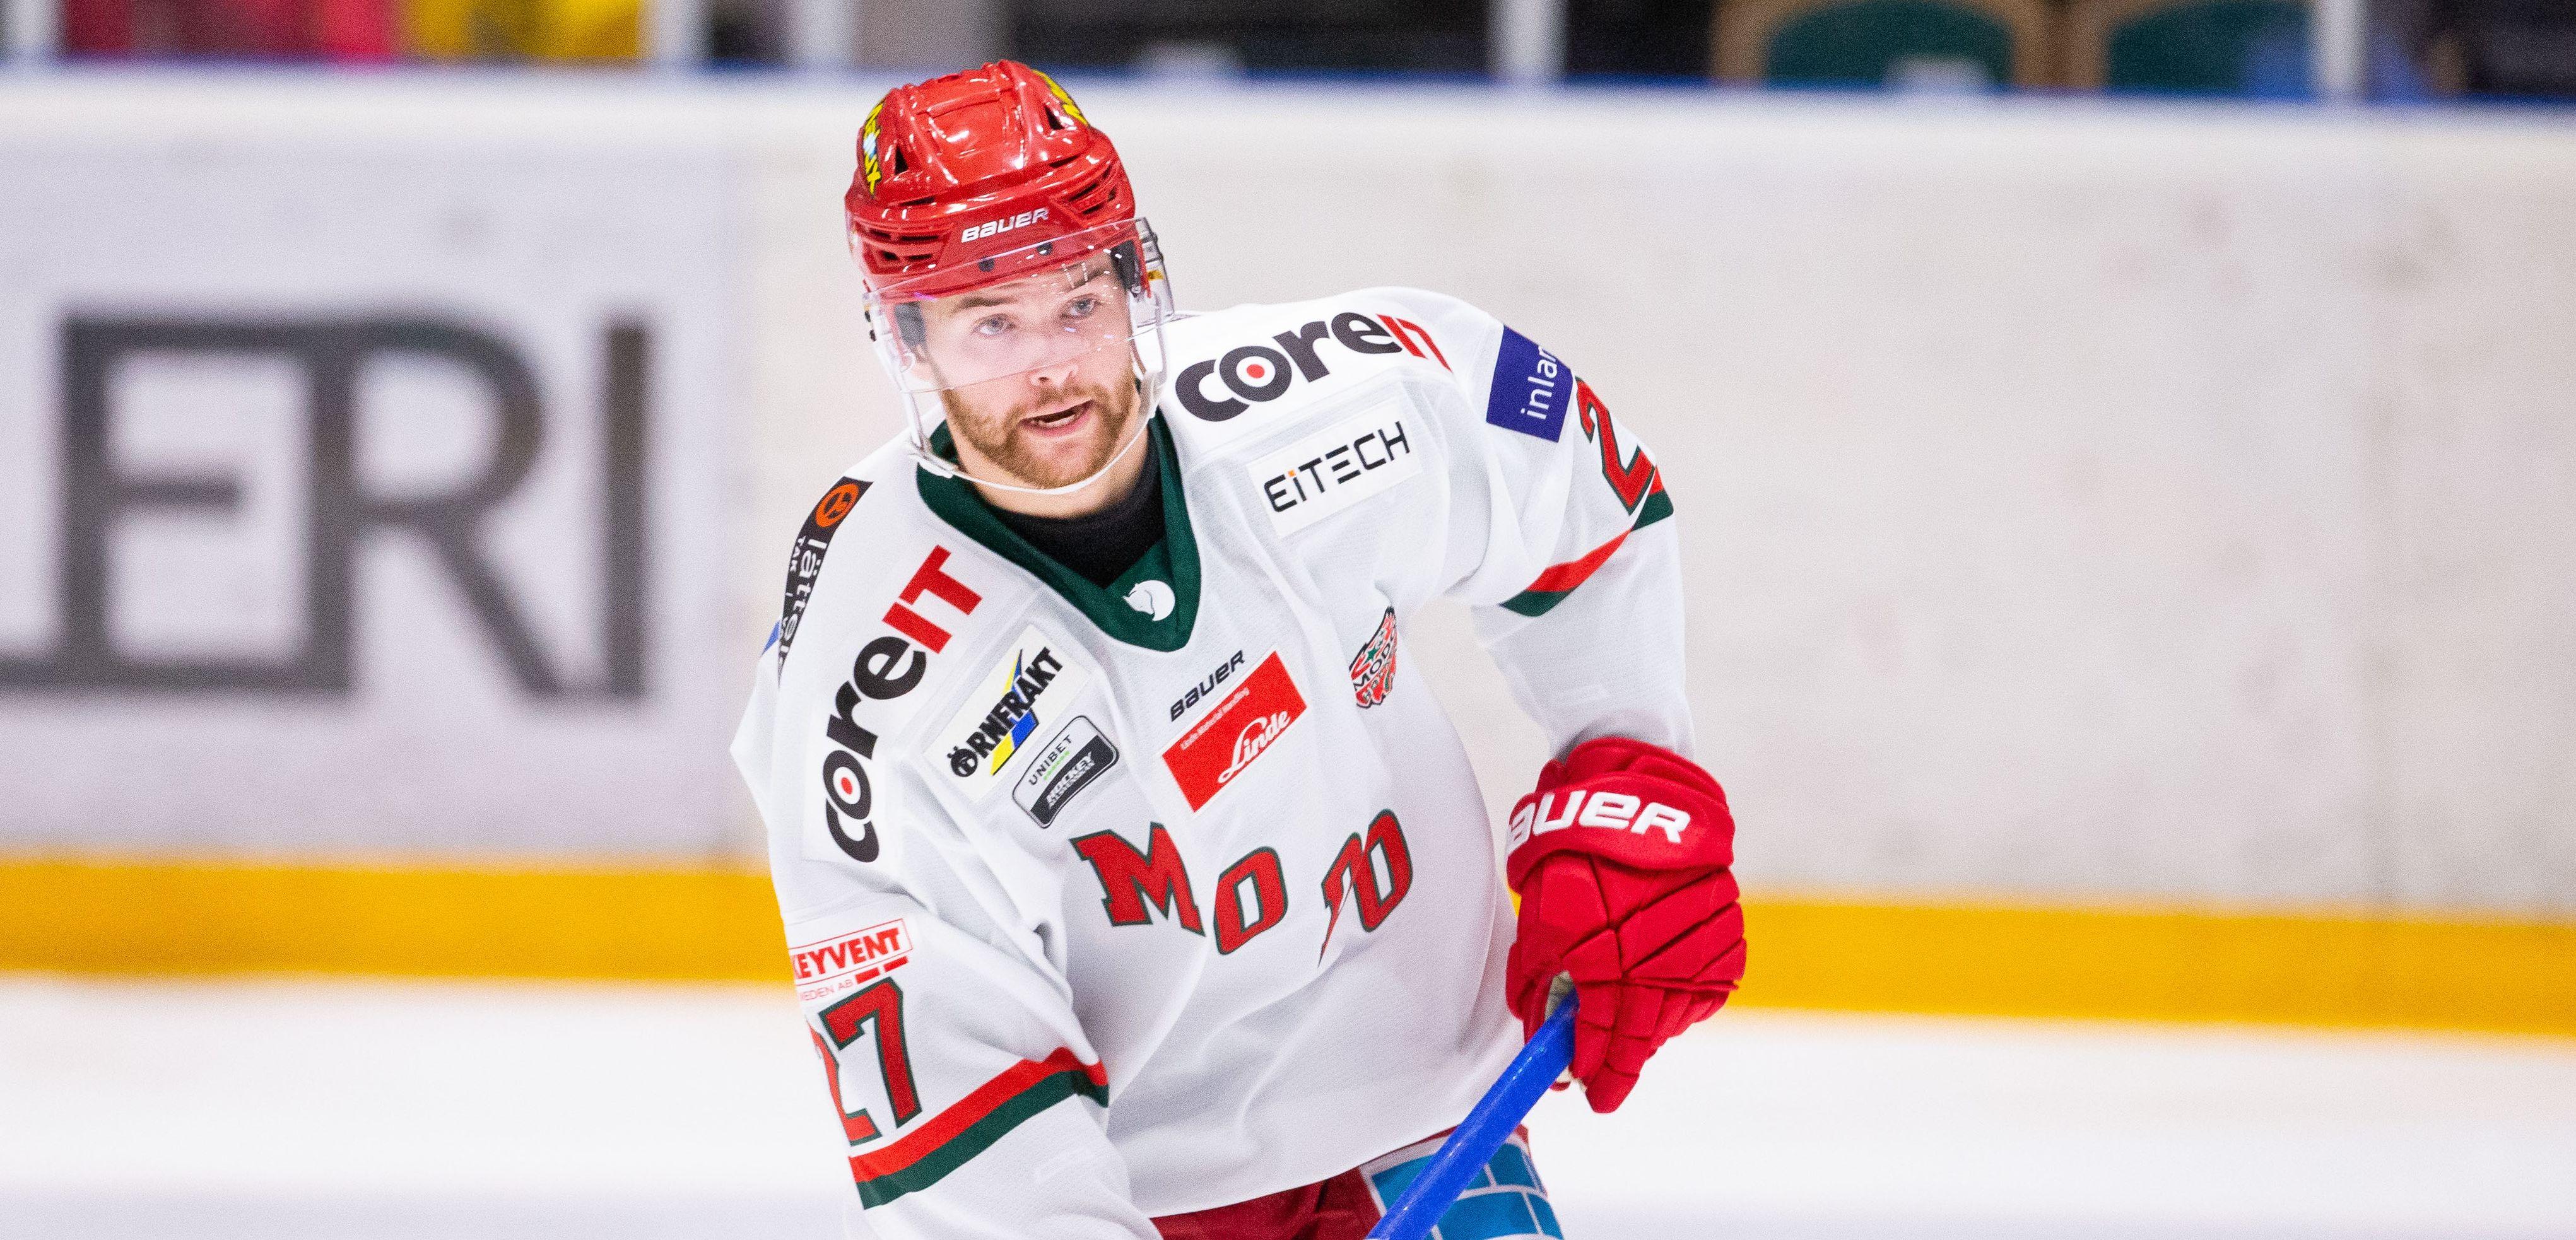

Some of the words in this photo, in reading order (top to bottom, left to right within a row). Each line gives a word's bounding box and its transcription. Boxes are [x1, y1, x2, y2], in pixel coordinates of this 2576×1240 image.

[1575, 375, 1656, 517] 2
[0, 311, 651, 699] ERI
[822, 544, 982, 863] coreIT
[946, 646, 1063, 778] ÖRNFRAKT
[1217, 710, 1291, 784] Linde
[1028, 734, 1072, 786] UNIBET
[1505, 790, 1691, 856] AUER
[792, 927, 901, 980] EYVENT
